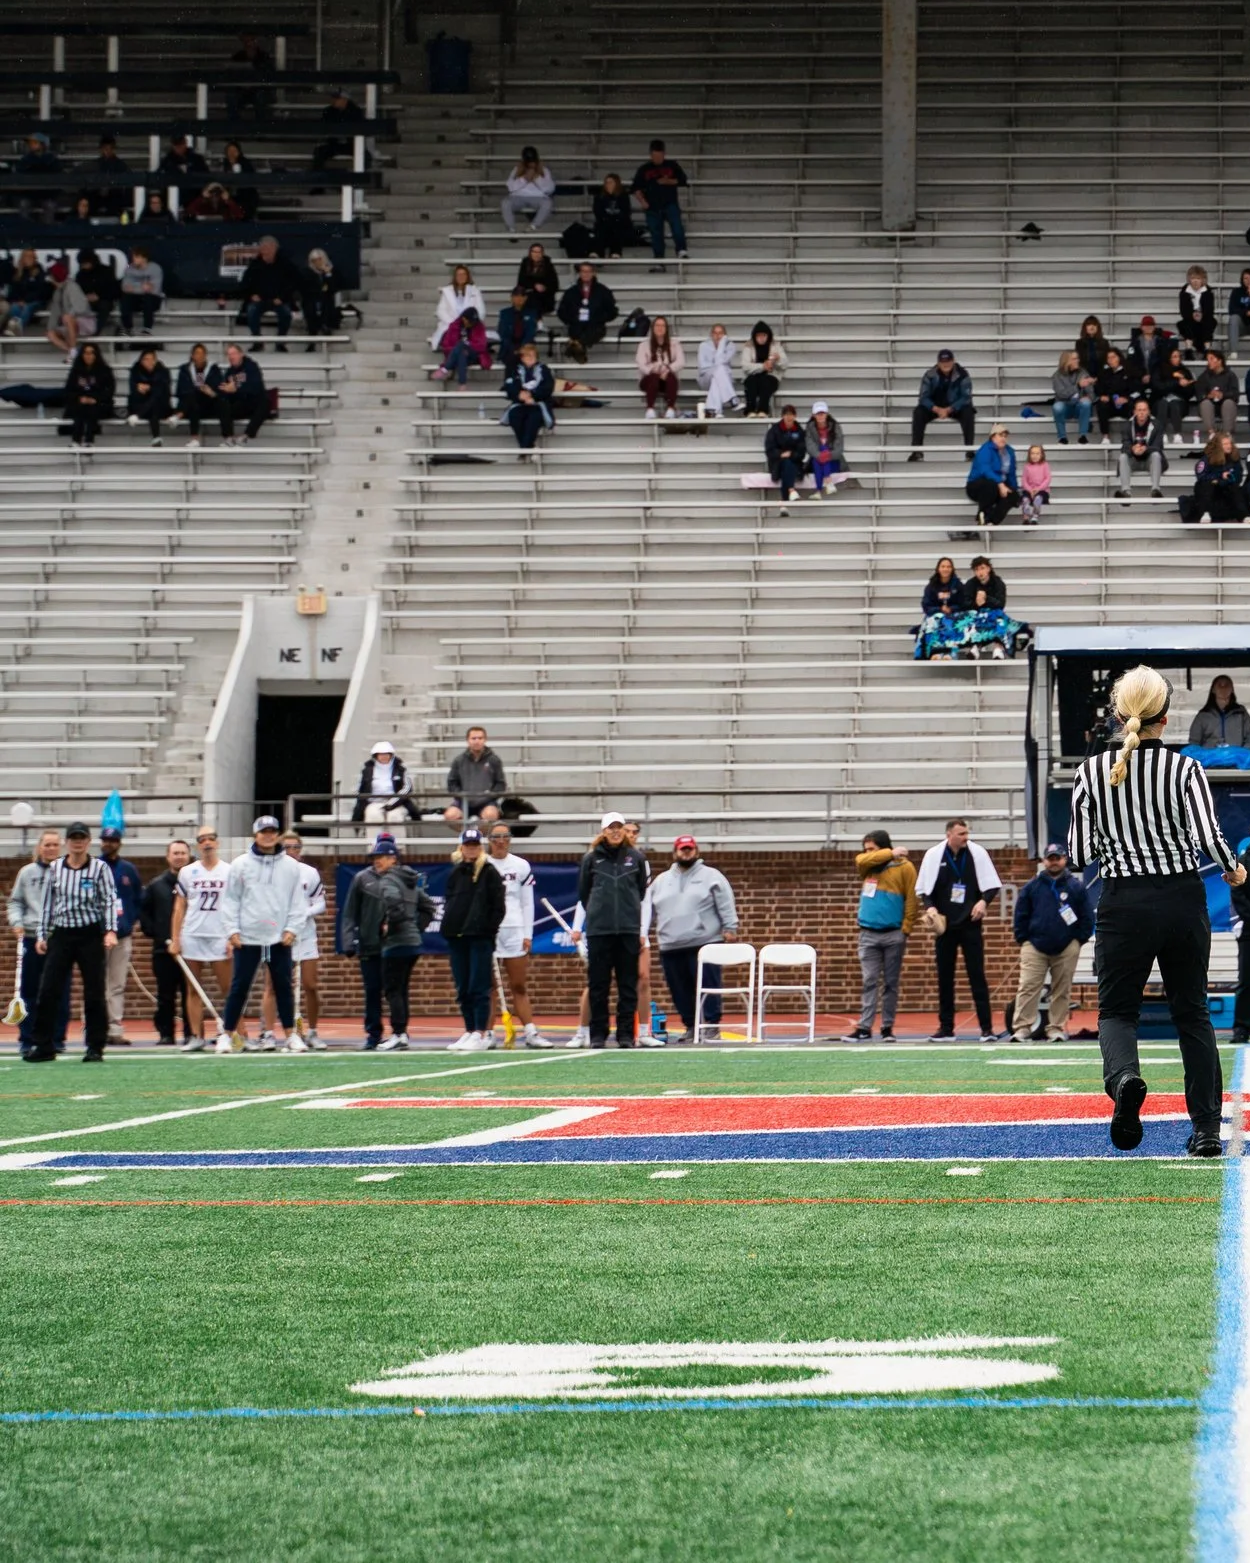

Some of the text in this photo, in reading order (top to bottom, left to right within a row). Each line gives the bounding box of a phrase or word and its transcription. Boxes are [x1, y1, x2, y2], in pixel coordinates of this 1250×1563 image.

[280, 647, 302, 663] NE
[321, 647, 343, 663] NF
[200, 891, 220, 912] 22
